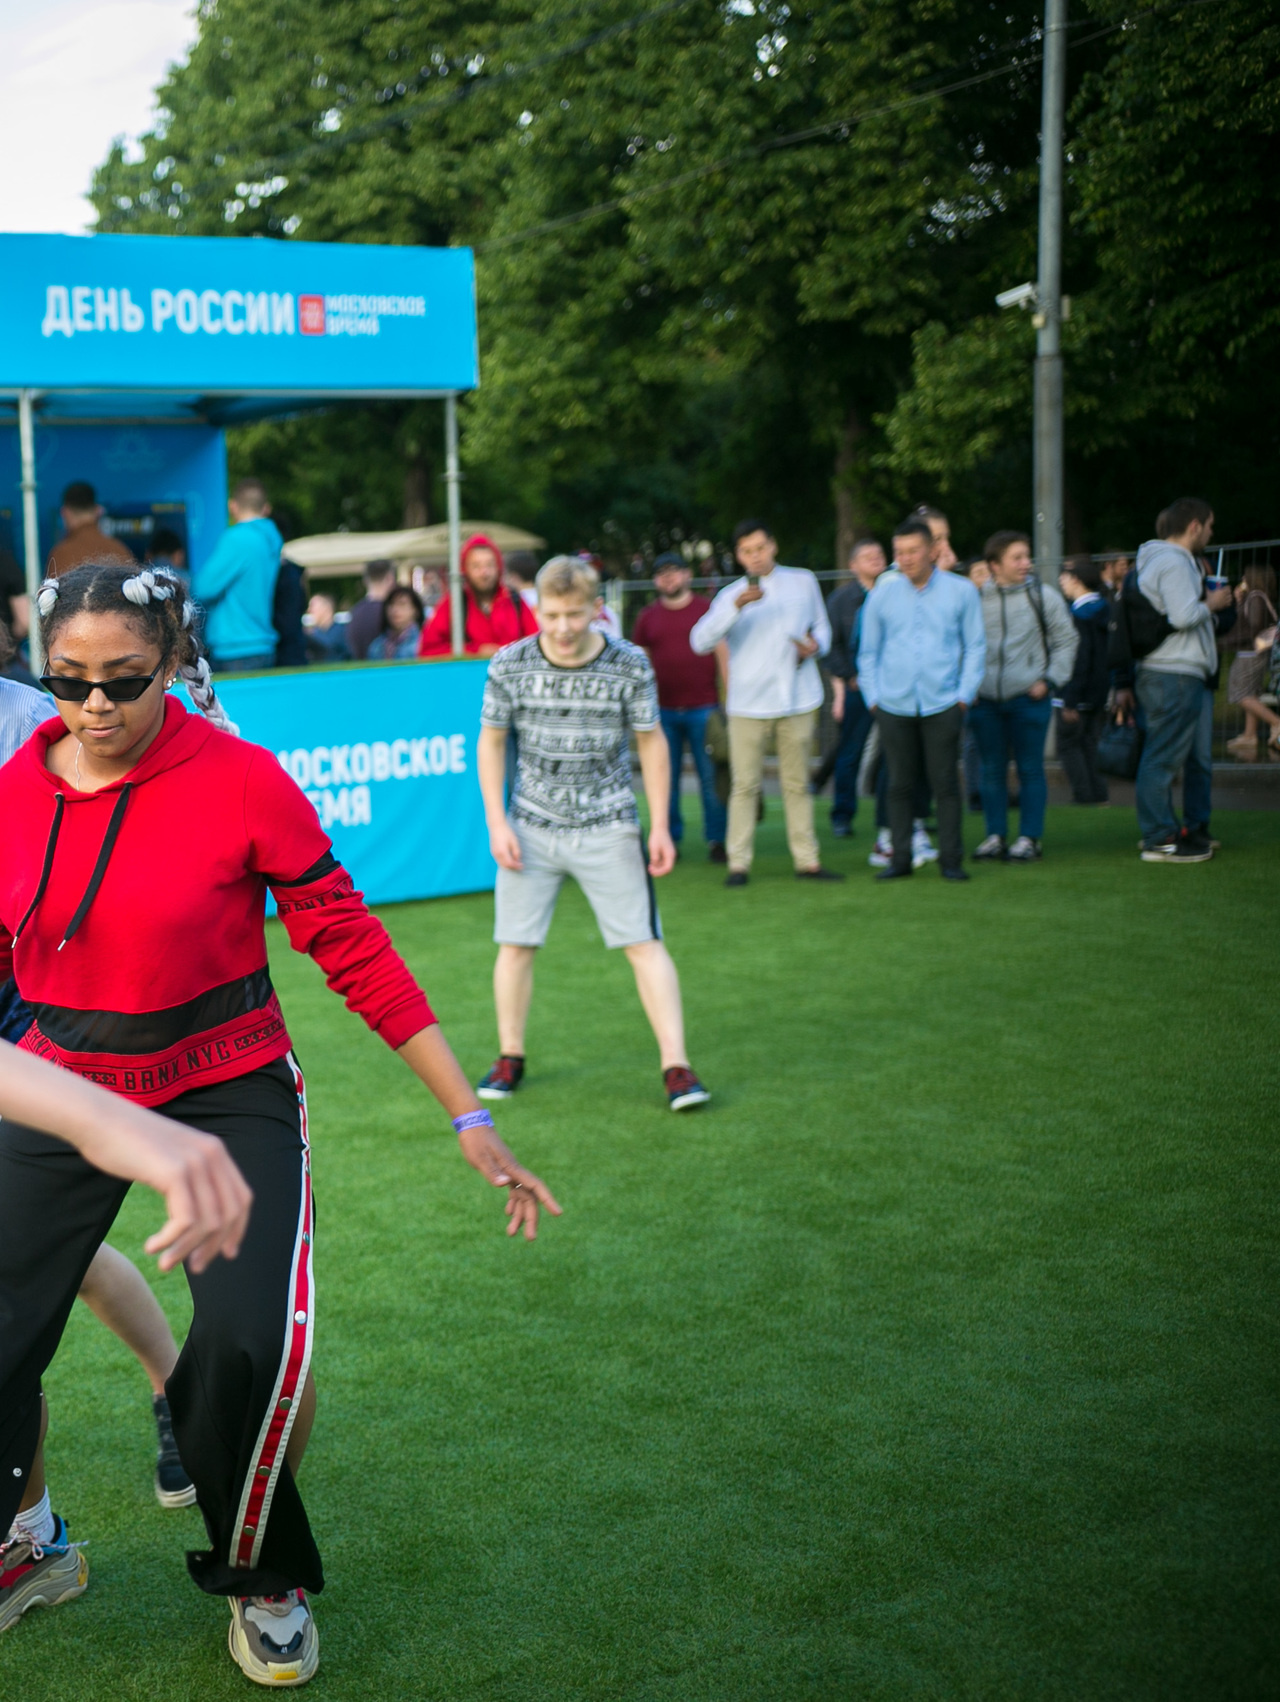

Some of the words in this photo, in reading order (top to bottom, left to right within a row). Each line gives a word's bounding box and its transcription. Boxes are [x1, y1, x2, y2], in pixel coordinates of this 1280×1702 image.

[41, 285, 145, 338] ДЕНЬ
[151, 288, 297, 336] РОССИИ
[302, 784, 372, 830] ЕМЯ
[186, 1040, 231, 1071] NYC
